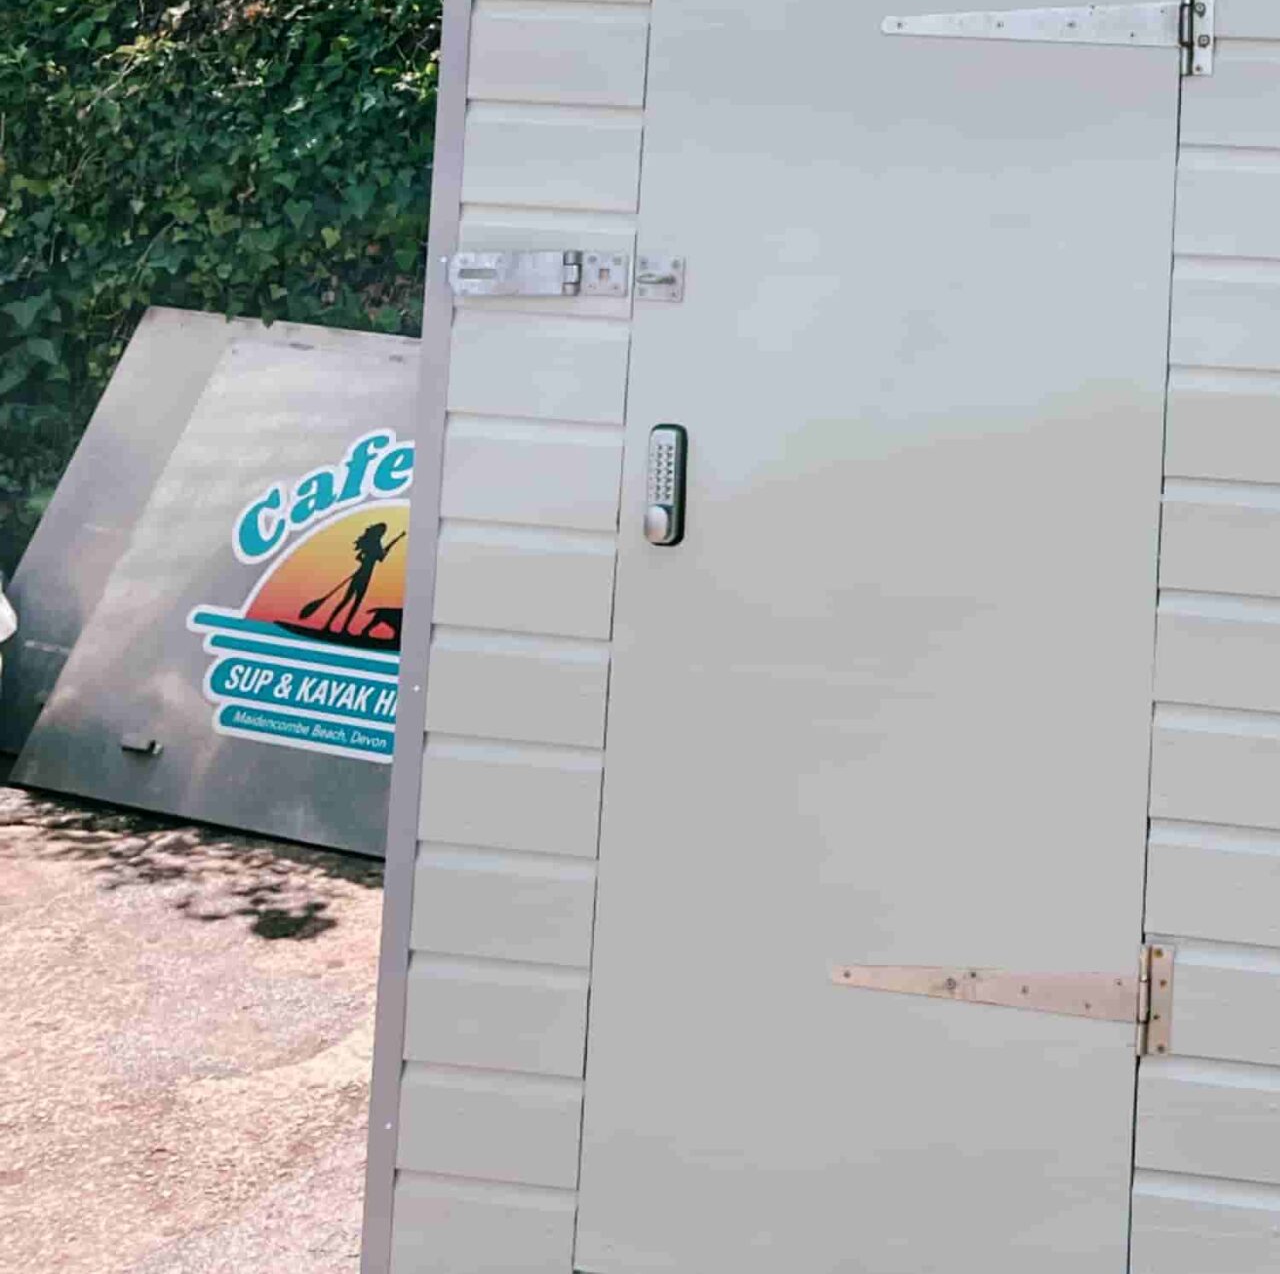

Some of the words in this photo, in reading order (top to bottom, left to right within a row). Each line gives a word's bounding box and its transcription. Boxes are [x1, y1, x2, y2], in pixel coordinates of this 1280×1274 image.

[238, 434, 415, 557] Cafe
[224, 664, 274, 694] SUP
[273, 673, 294, 699] &
[296, 676, 375, 712] KAYAK
[232, 711, 310, 734] Maidencombe
[351, 731, 387, 748] Devon
